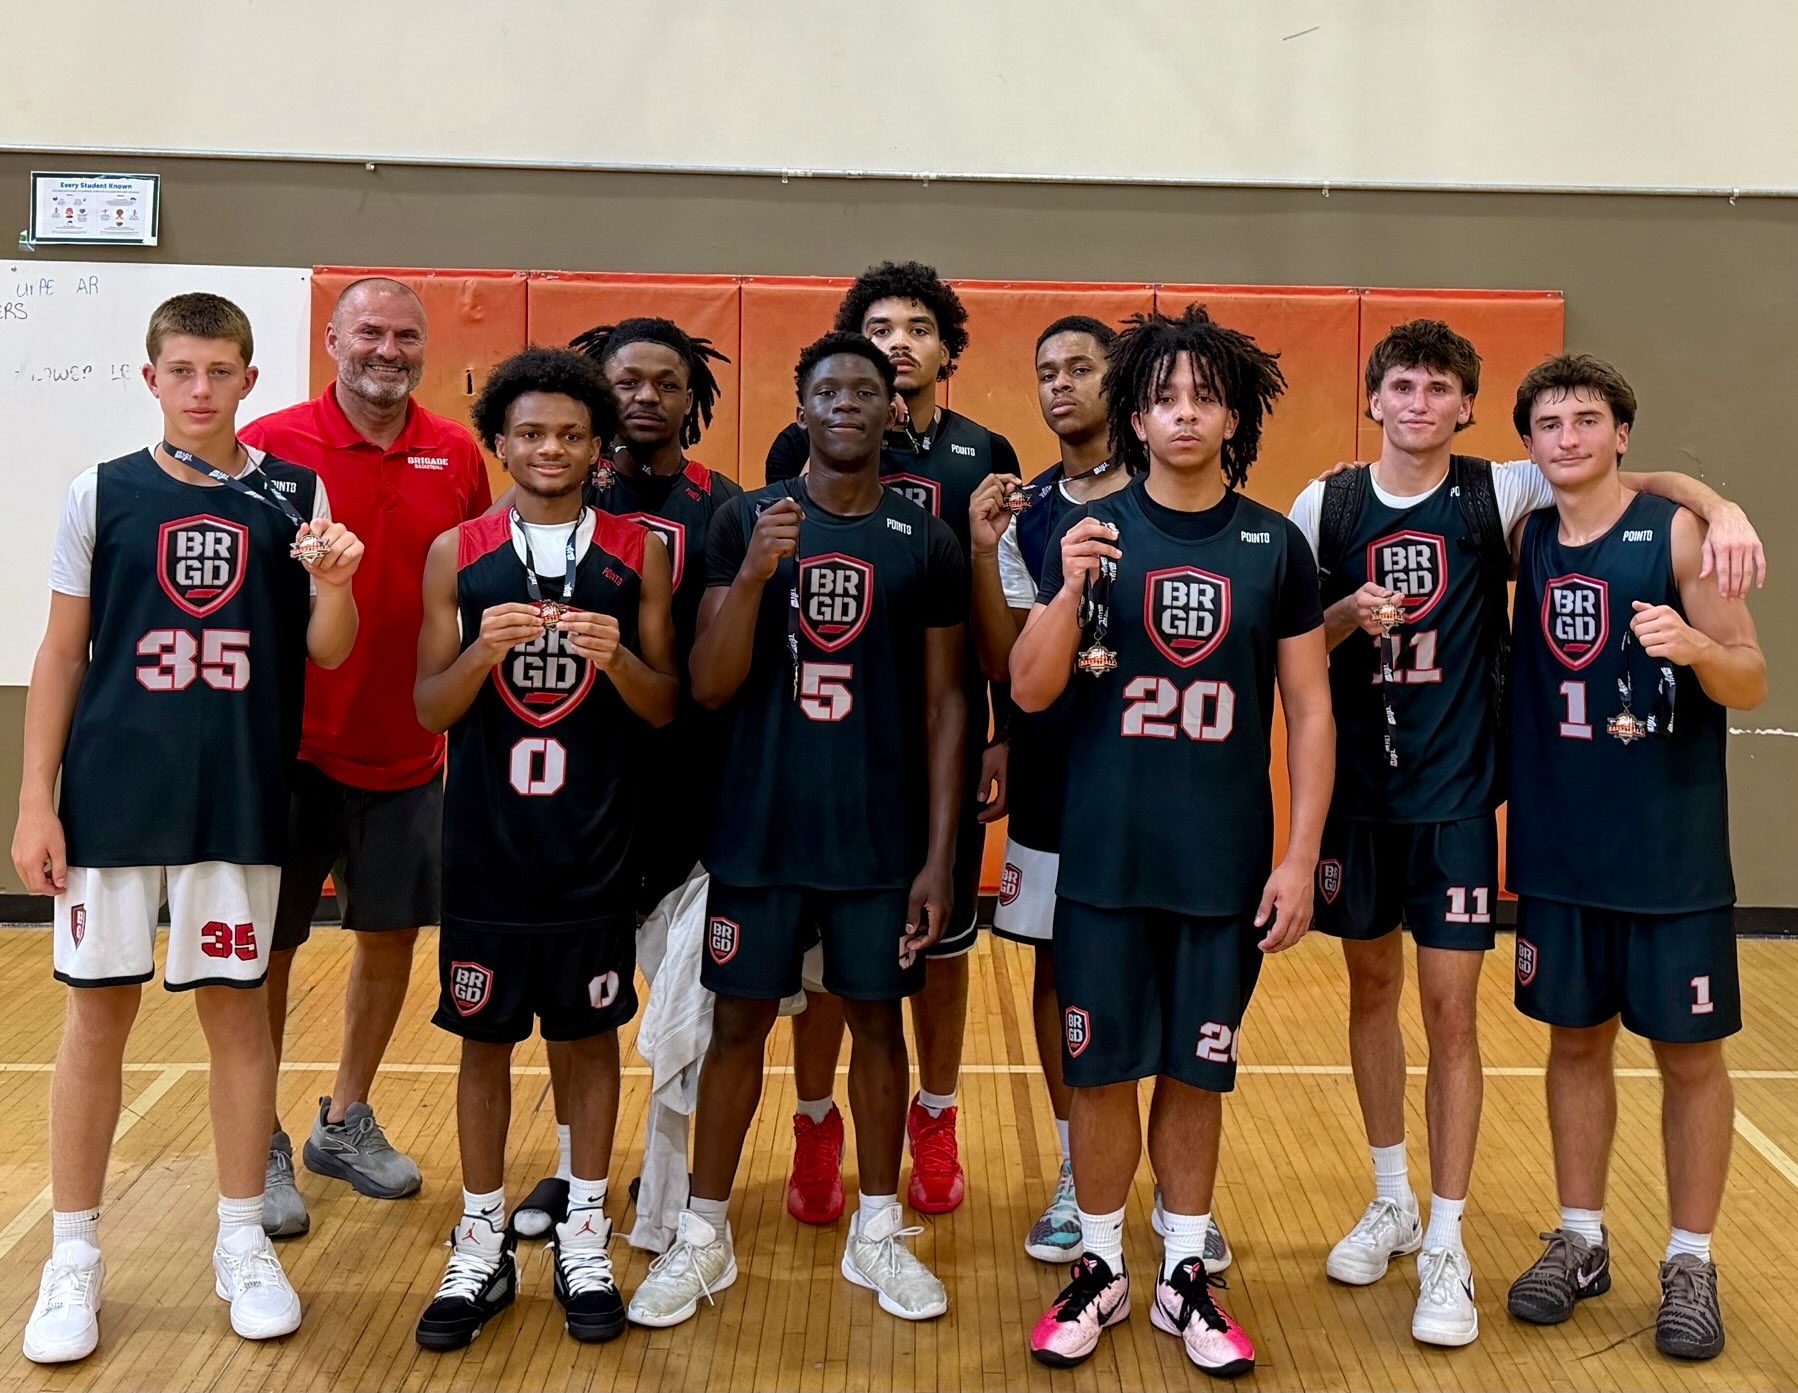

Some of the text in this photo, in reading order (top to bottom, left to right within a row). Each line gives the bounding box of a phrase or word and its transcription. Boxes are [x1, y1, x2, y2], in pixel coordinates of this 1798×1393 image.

[407, 456, 449, 466] BRIGADE
[176, 531, 232, 558] BR
[1383, 544, 1432, 571] BR
[176, 559, 230, 586] GD
[810, 568, 859, 595] BR
[1385, 570, 1433, 595] GD
[809, 595, 857, 622] GD
[1162, 581, 1215, 609] BR
[1553, 589, 1596, 615] BR
[1161, 608, 1214, 637] GD
[1555, 616, 1596, 641] GD
[136, 628, 251, 691] 35
[512, 655, 577, 688] GD
[800, 661, 853, 722] 5
[1120, 675, 1236, 742] 20
[1559, 680, 1593, 740] 1
[509, 737, 567, 796] 0
[1445, 886, 1491, 923] 11
[201, 920, 258, 961] 35
[713, 922, 732, 939] BR
[713, 936, 731, 952] GD
[455, 967, 484, 987] BR
[587, 969, 620, 1009] 0
[455, 984, 481, 1003] GD
[1690, 975, 1714, 1014] 1
[1068, 1014, 1083, 1029] BR
[1068, 1028, 1083, 1043] GD
[1196, 1021, 1240, 1063] 2
